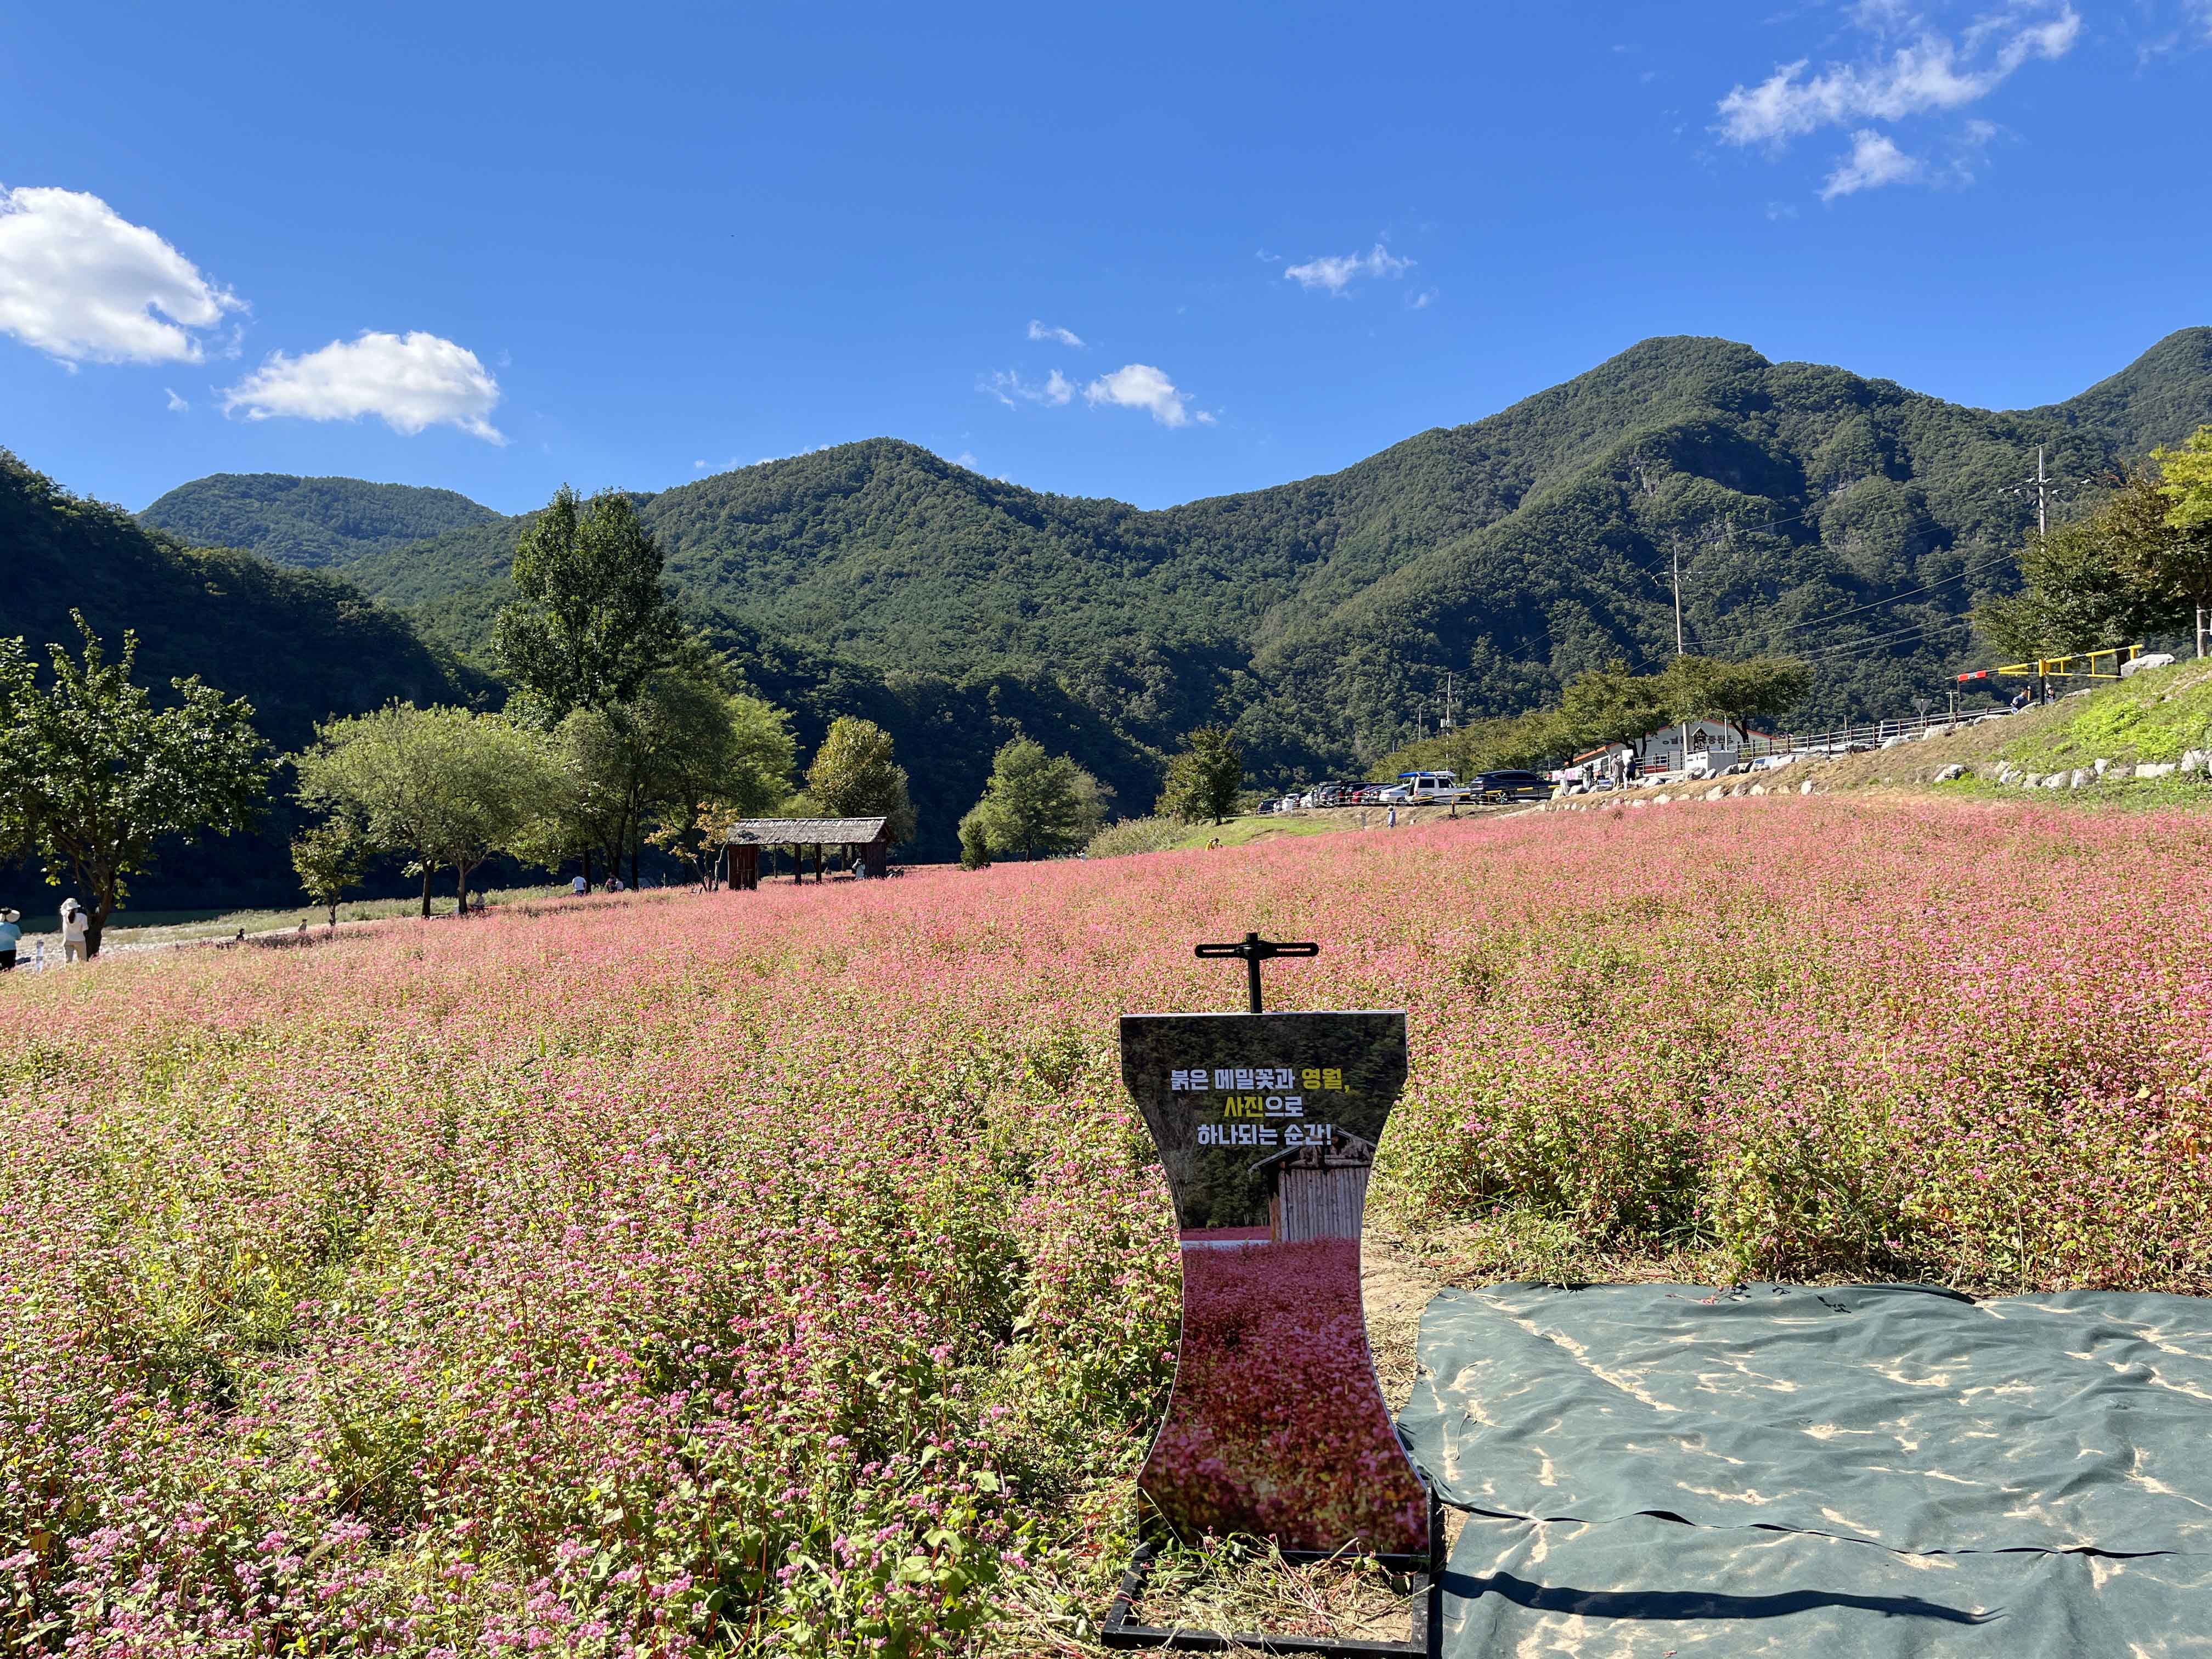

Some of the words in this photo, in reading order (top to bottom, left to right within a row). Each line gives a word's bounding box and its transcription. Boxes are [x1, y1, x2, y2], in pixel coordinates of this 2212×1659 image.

[1171, 1069, 1209, 1090] 붉은
[1214, 1068, 1295, 1090] 메밀꽃과
[1301, 1068, 1350, 1093] 영월,
[1224, 1096, 1304, 1117] 사진으로
[1197, 1124, 1278, 1145] 하나되는
[1284, 1123, 1331, 1145] 순간!
